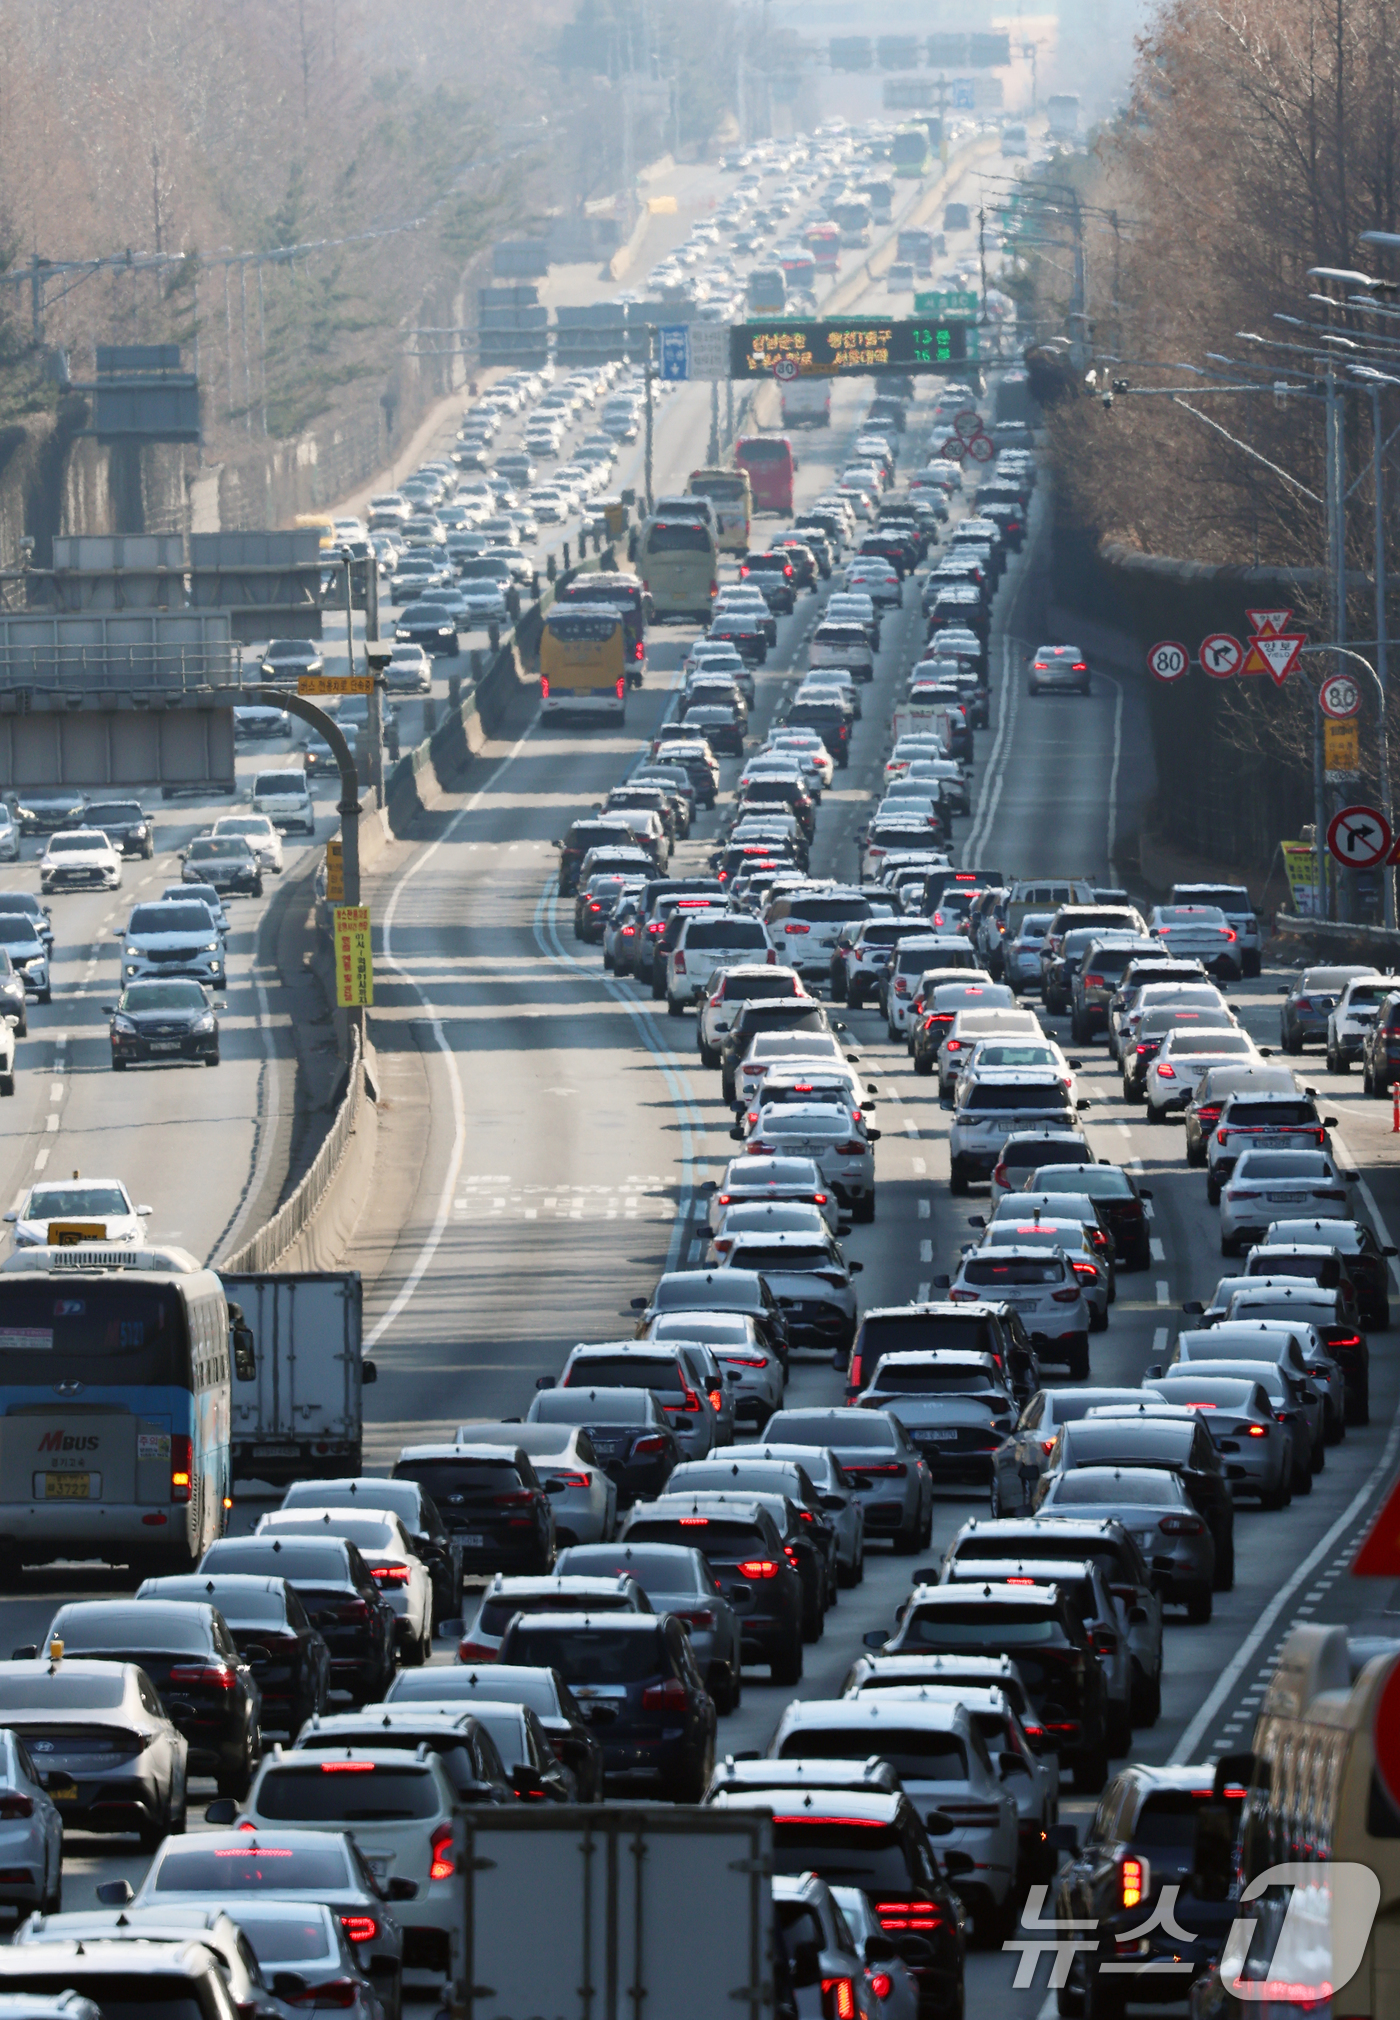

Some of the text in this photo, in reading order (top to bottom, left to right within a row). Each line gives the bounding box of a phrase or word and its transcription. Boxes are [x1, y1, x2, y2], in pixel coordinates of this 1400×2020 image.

[1264, 642, 1291, 652] 양보
[1157, 651, 1181, 671] 80
[300, 680, 315, 692] 버스
[319, 680, 347, 692] 전용차로
[1329, 687, 1355, 708] 80
[139, 1436, 158, 1446] 주의
[51, 1458, 86, 1467] 경기고속
